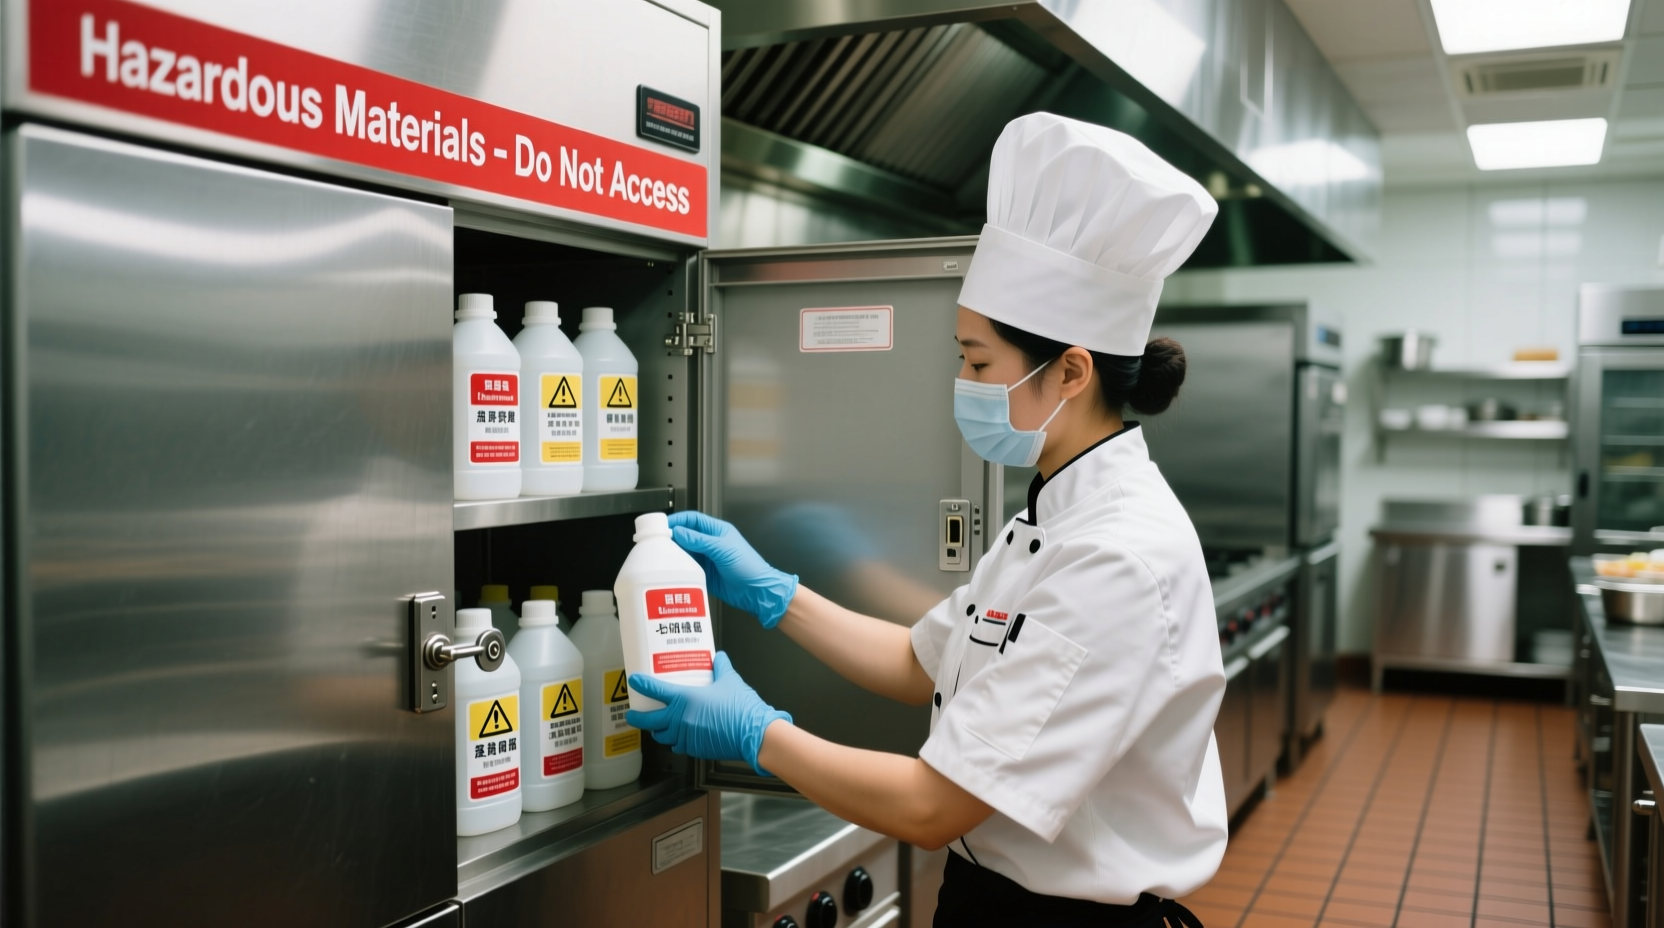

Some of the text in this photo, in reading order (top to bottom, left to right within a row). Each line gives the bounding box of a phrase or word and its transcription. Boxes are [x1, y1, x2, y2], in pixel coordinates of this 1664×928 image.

[80, 13, 323, 129] Hazardous
[335, 84, 487, 167] Materials
[515, 133, 552, 183] Do
[560, 145, 604, 195] Not
[609, 160, 690, 215] Access
